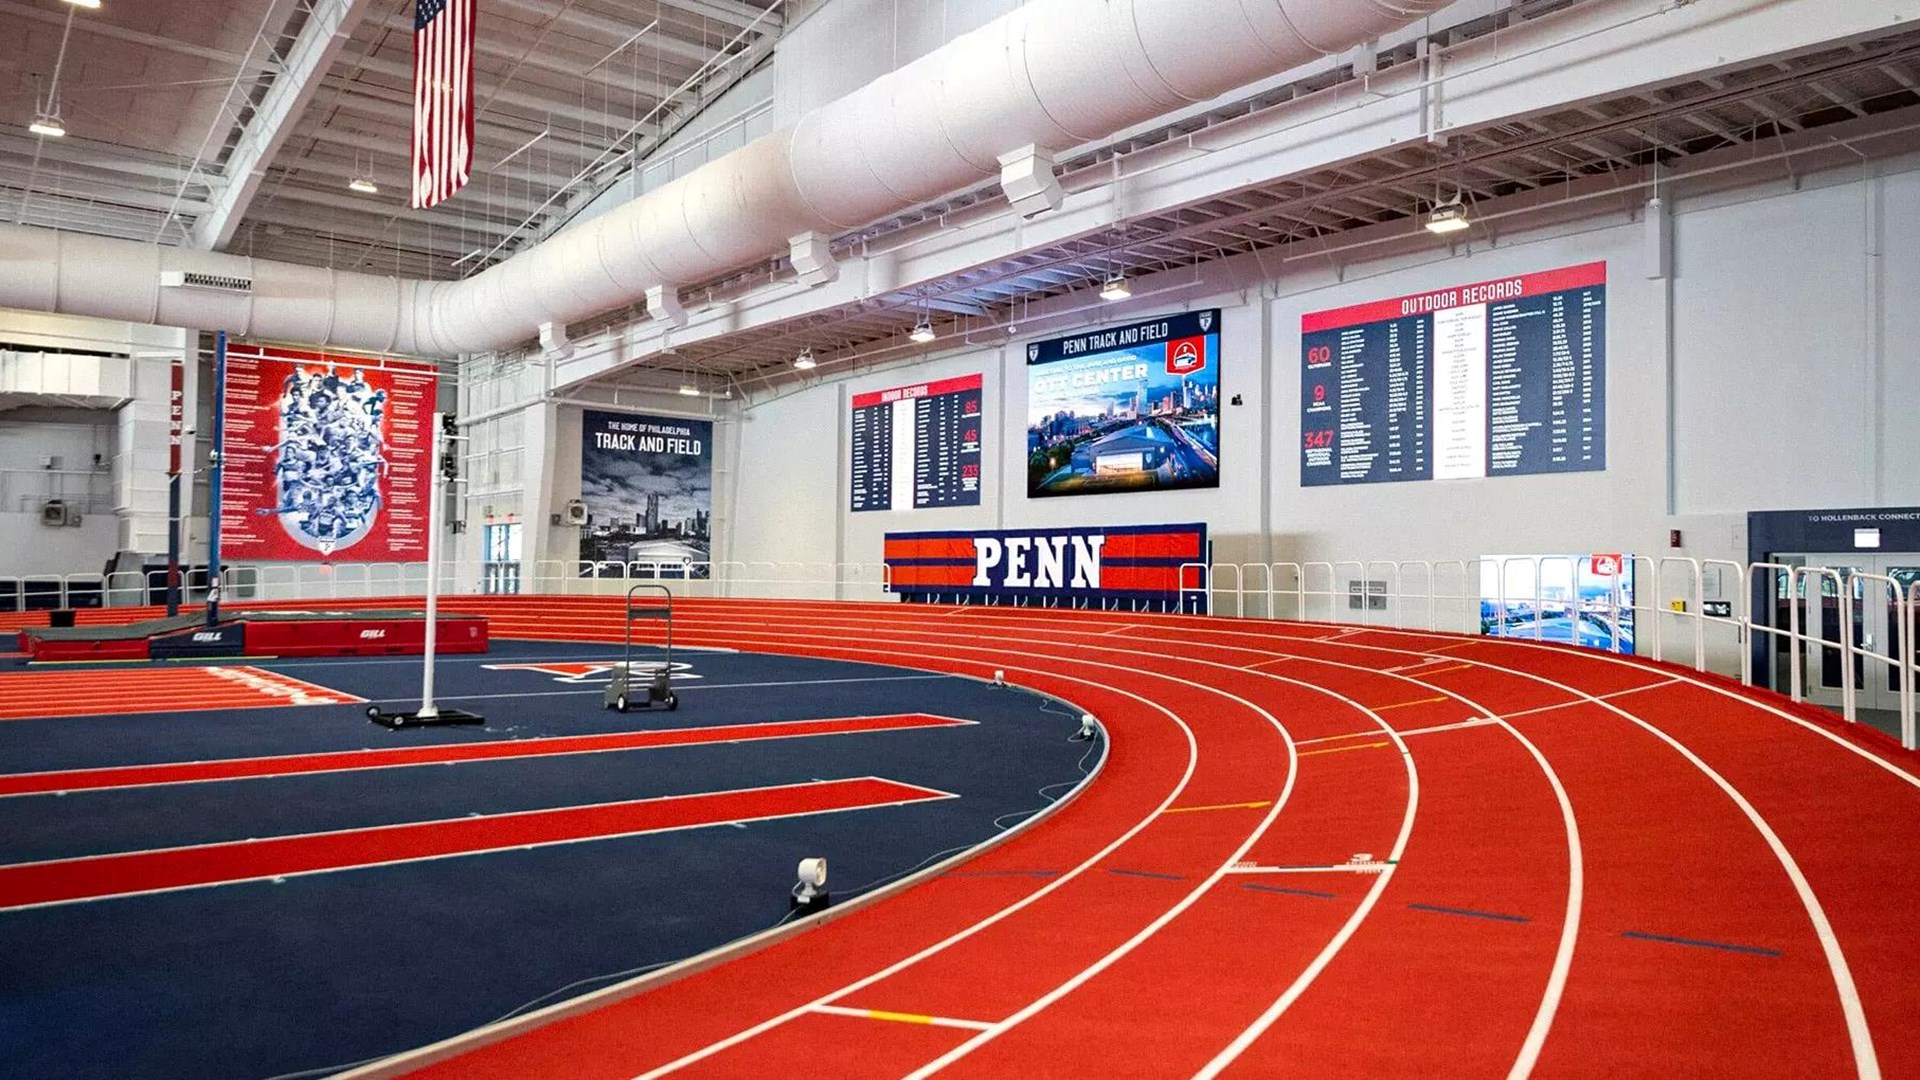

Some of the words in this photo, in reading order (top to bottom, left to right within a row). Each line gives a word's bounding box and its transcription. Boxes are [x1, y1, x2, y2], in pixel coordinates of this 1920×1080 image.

[1401, 291, 1457, 315] OUTDOOR
[1462, 279, 1523, 305] RECORDS
[1062, 337, 1087, 355] PENN
[1088, 332, 1117, 350] TRACK
[1119, 328, 1138, 345] AND
[1140, 322, 1168, 341] FIELD
[1308, 346, 1331, 363] 60
[1071, 363, 1149, 389] CENTER
[608, 421, 620, 430] THE
[621, 422, 638, 432] HOME
[639, 423, 648, 433] OF
[648, 424, 690, 436] PHILADELPHIA
[595, 432, 636, 451] TRACK
[639, 436, 664, 453] AND
[667, 438, 701, 455] FIELD
[1304, 430, 1334, 448] 347
[1821, 514, 1877, 522] HOLLENBACK
[972, 535, 1105, 589] PENN
[192, 631, 223, 642] GILL
[360, 629, 386, 639] GILL
